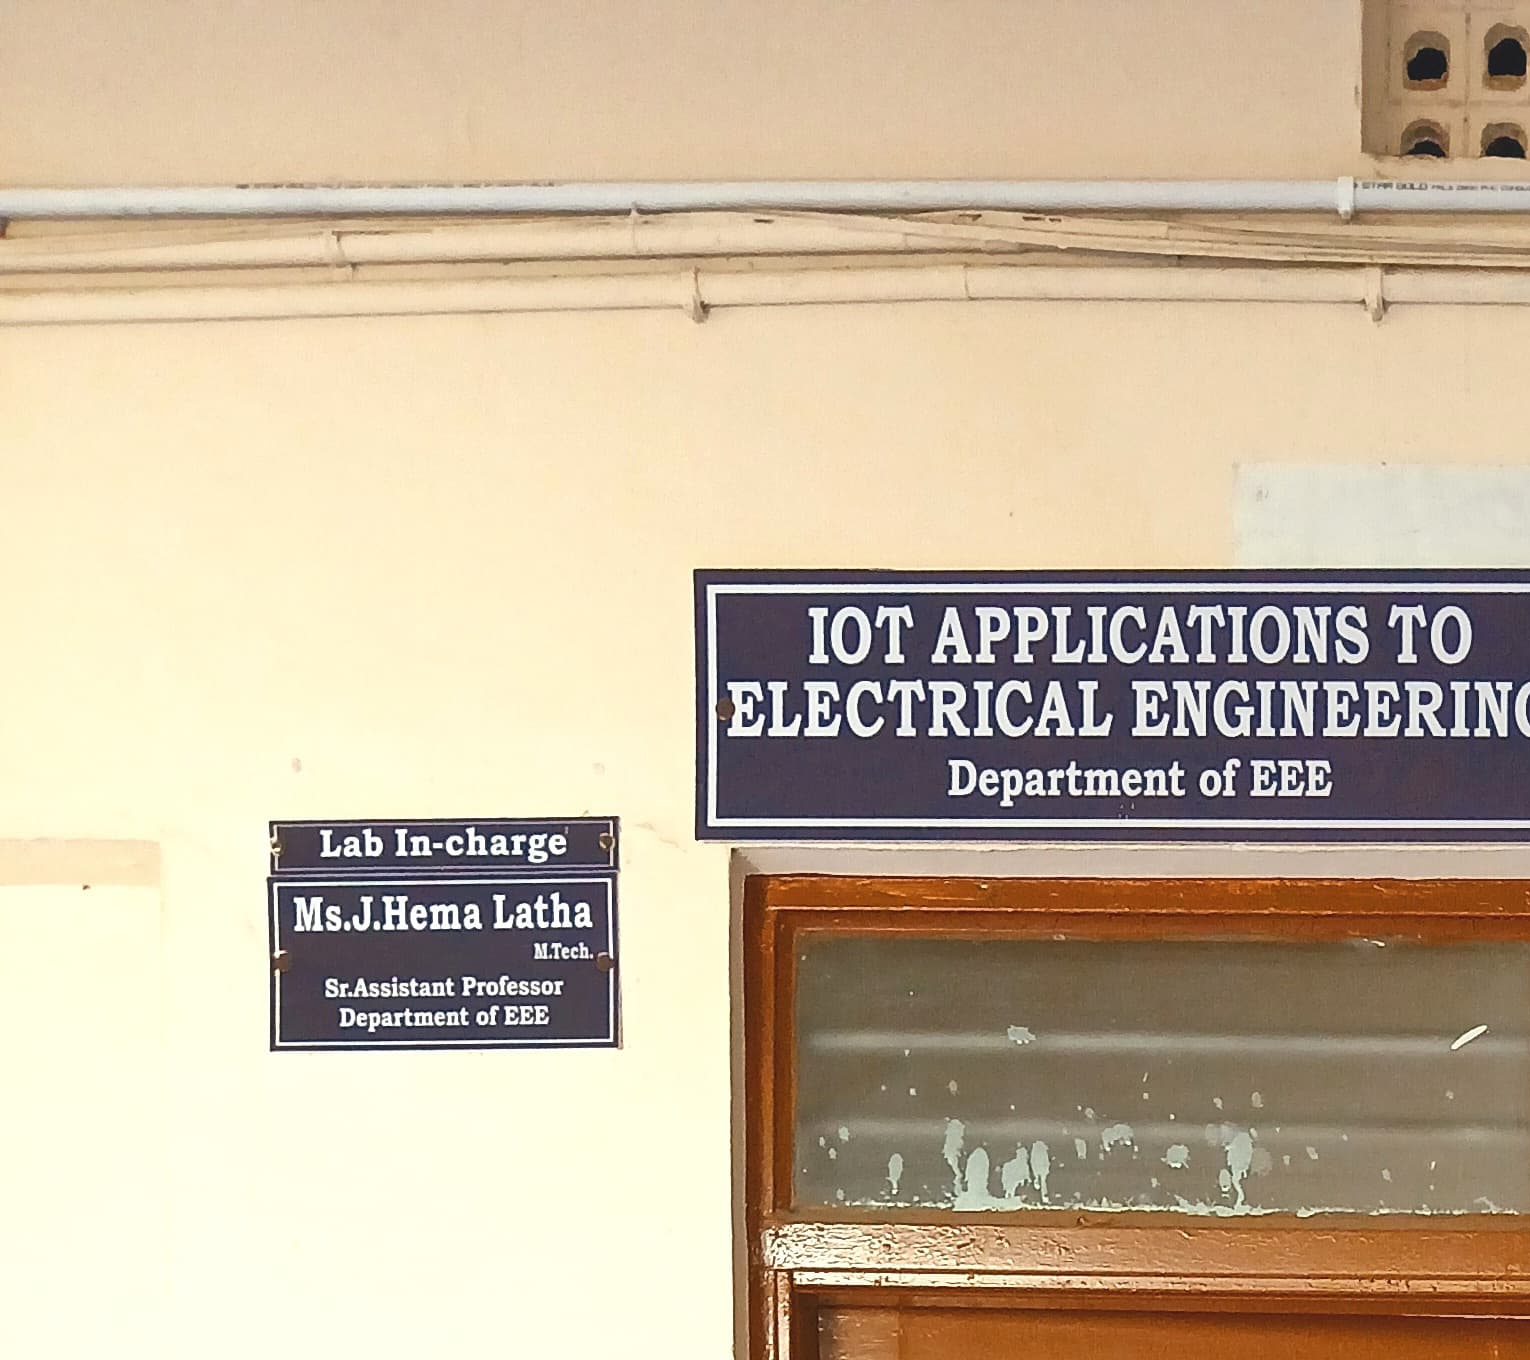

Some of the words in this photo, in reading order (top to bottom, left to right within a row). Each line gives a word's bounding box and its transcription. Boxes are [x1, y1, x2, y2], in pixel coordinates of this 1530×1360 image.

[808, 605, 914, 665] IOT
[931, 604, 1370, 664] APPLICATIONS
[1388, 604, 1473, 665] TO
[726, 680, 1114, 738] ELECTRICAL
[947, 759, 1186, 809] Department
[1199, 758, 1242, 797] of
[1249, 759, 1333, 798] EEE
[319, 829, 384, 858] Lab
[394, 827, 568, 863] In-charge
[293, 895, 483, 932] Ms.J.Hema
[492, 891, 593, 930] Latha
[325, 976, 455, 998] Sr.Assistant
[461, 976, 564, 997] Professor
[339, 1007, 470, 1033] Department
[475, 1006, 500, 1026] of
[504, 1005, 550, 1026] EEE
